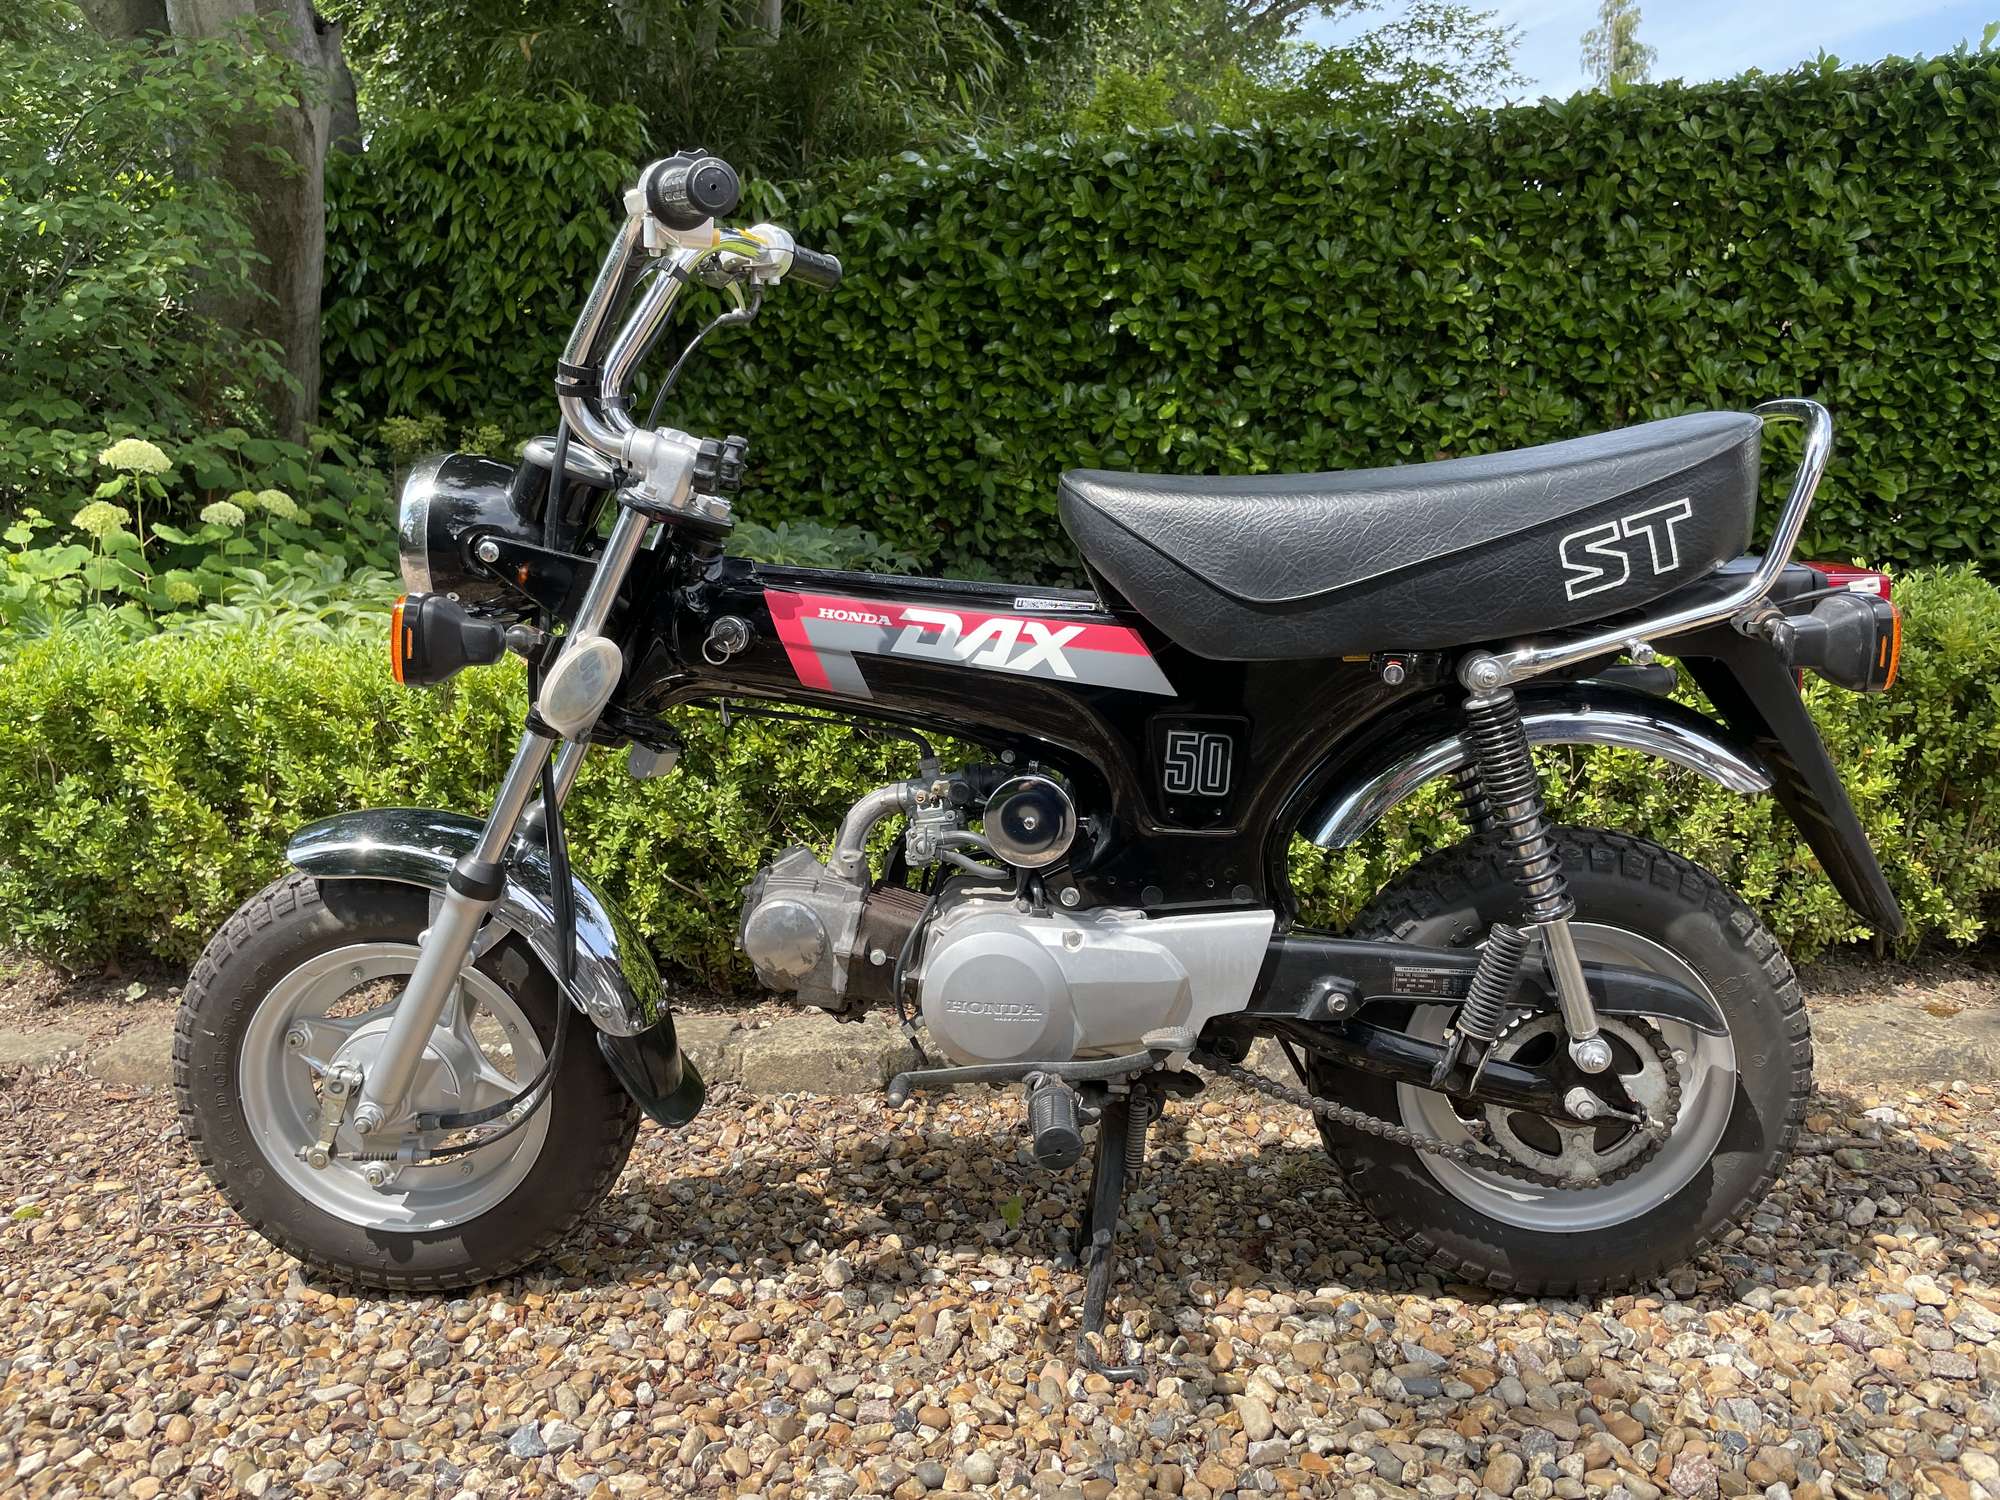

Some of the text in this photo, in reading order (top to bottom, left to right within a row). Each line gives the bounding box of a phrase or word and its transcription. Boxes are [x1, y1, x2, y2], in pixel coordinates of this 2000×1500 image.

[1558, 497, 1693, 602] ST
[817, 607, 1088, 679] HONDA DAX
[1164, 729, 1233, 797] 50
[945, 1000, 1043, 1016] HONDA
